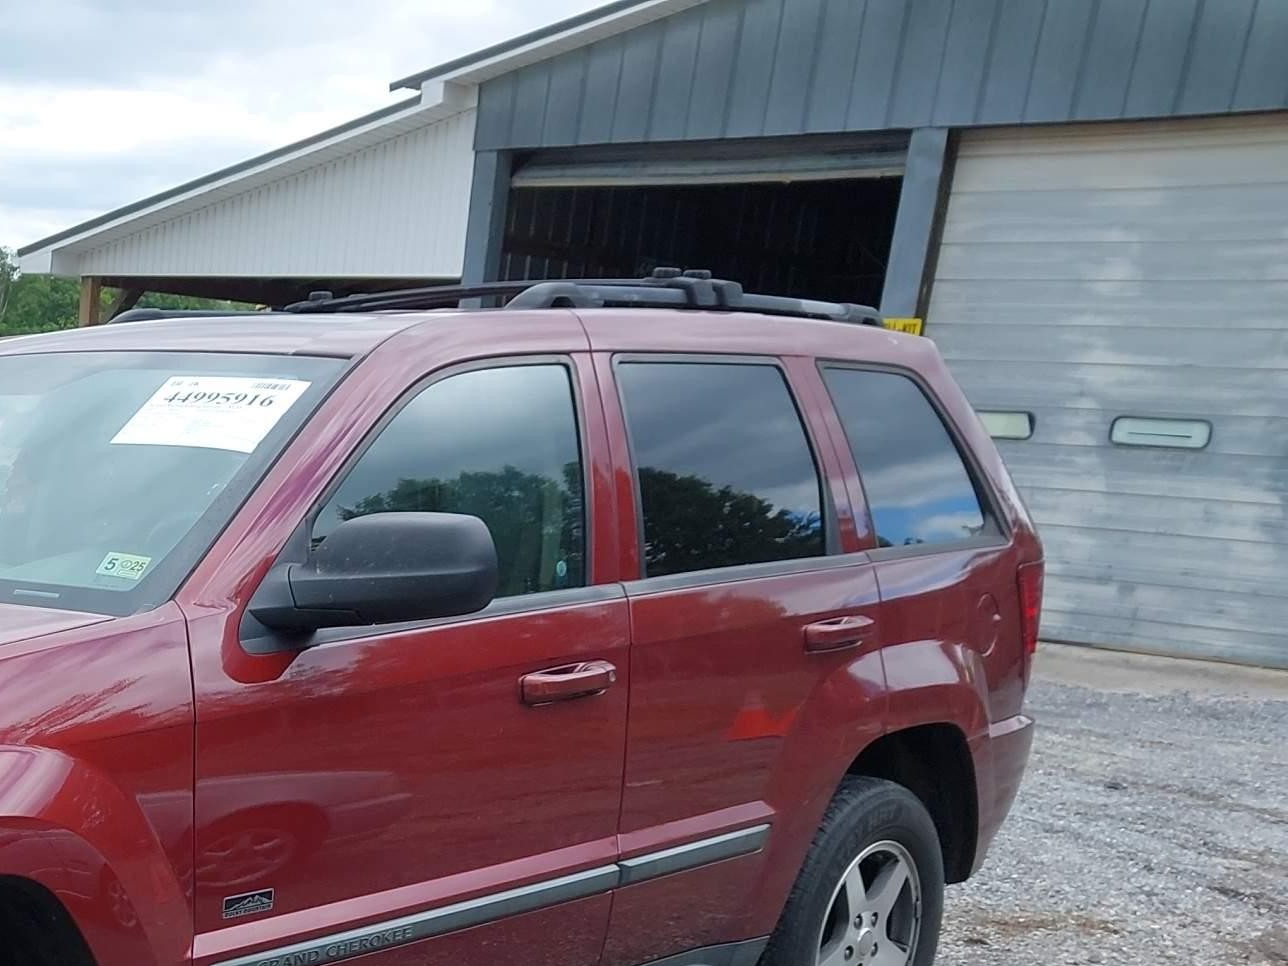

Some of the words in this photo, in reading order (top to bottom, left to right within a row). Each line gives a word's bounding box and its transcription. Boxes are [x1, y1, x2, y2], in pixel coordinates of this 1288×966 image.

[164, 391, 275, 407] 44995916
[104, 558, 119, 571] 5
[129, 560, 147, 571] 25
[326, 927, 413, 957] CHEROKEE
